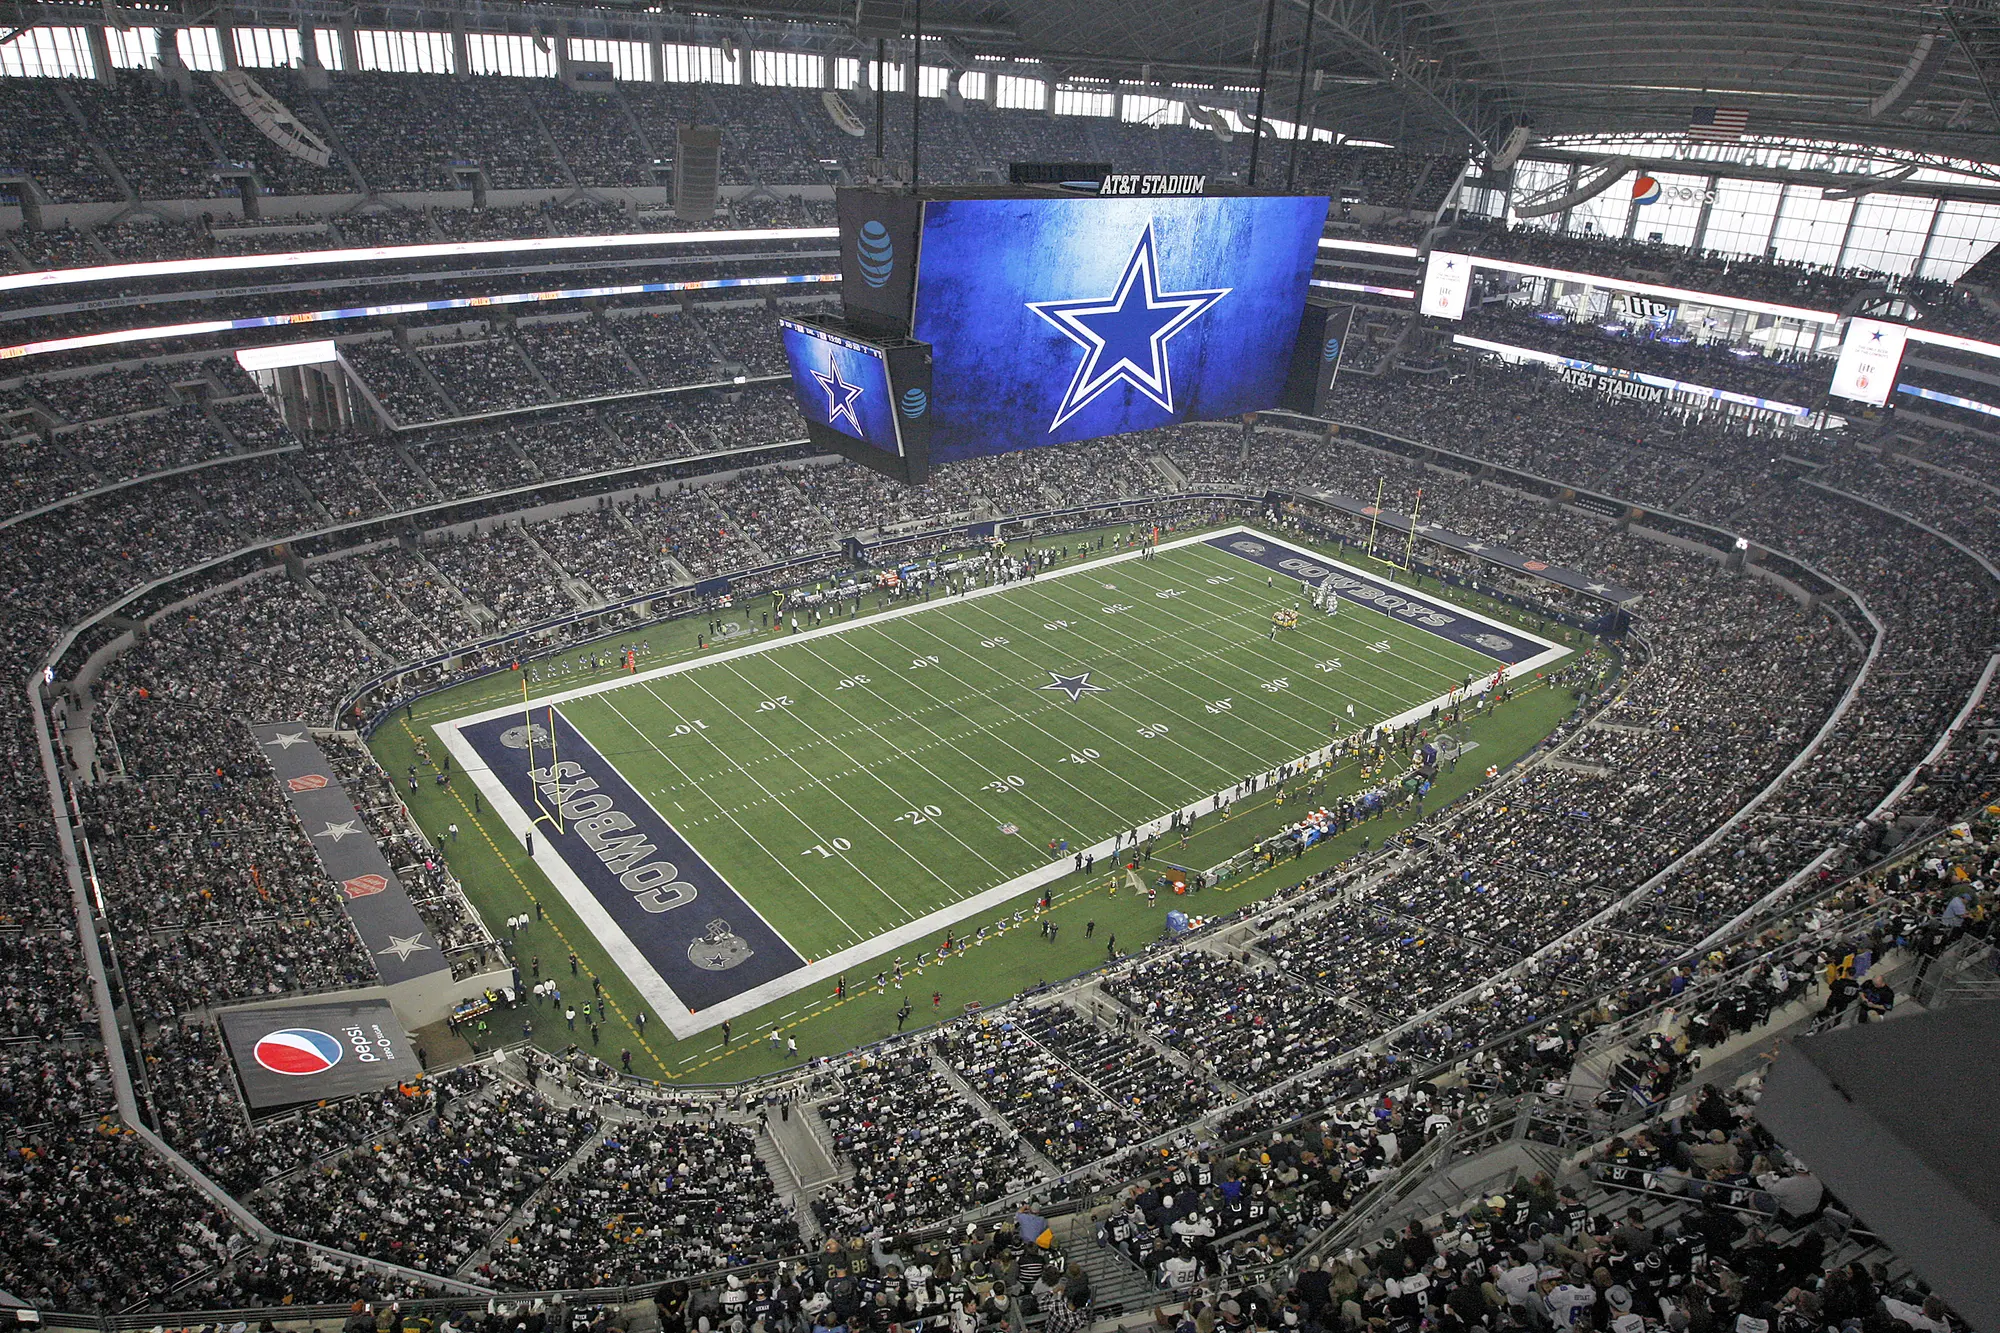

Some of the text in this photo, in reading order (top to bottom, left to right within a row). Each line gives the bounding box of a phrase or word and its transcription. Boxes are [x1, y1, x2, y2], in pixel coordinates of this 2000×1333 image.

[1100, 175, 1206, 195] AT&T STADIUM
[88, 301, 102, 309] BOB
[103, 299, 126, 307] HAYES
[1622, 294, 1668, 319] Lite
[1858, 362, 1876, 374] Lite
[1561, 368, 1597, 388] AT&T
[1598, 377, 1663, 403] STADIUM
[1206, 576, 1230, 585] 10
[1155, 588, 1181, 600] 20
[1278, 558, 1456, 628] COWBOYS
[1101, 603, 1128, 615] 30
[1043, 619, 1068, 631] 40
[980, 636, 1010, 649] 50
[1365, 641, 1391, 653] 10
[912, 654, 940, 669] 40
[1314, 659, 1342, 673] 20
[839, 674, 871, 689] 30
[1260, 678, 1289, 693] 30
[760, 695, 794, 711] 20
[1204, 700, 1233, 715] 40
[674, 719, 710, 735] 10
[1136, 723, 1169, 739] 50
[1070, 747, 1100, 765] 40
[989, 775, 1025, 794] 30
[904, 804, 942, 825] 20
[527, 761, 698, 914] COWBOYS
[812, 837, 852, 859] 10
[371, 1024, 385, 1039] SUGAR
[341, 1024, 381, 1062] pepsi
[383, 1047, 395, 1060] ZERO
[1172, 1171, 1187, 1185] 88
[1198, 1172, 1211, 1186] 21
[1612, 1167, 1628, 1180] 87
[1249, 1206, 1264, 1218] 21
[1514, 1208, 1529, 1225] 12
[1113, 1223, 1131, 1242] 50
[1417, 1291, 1428, 1313] 9
